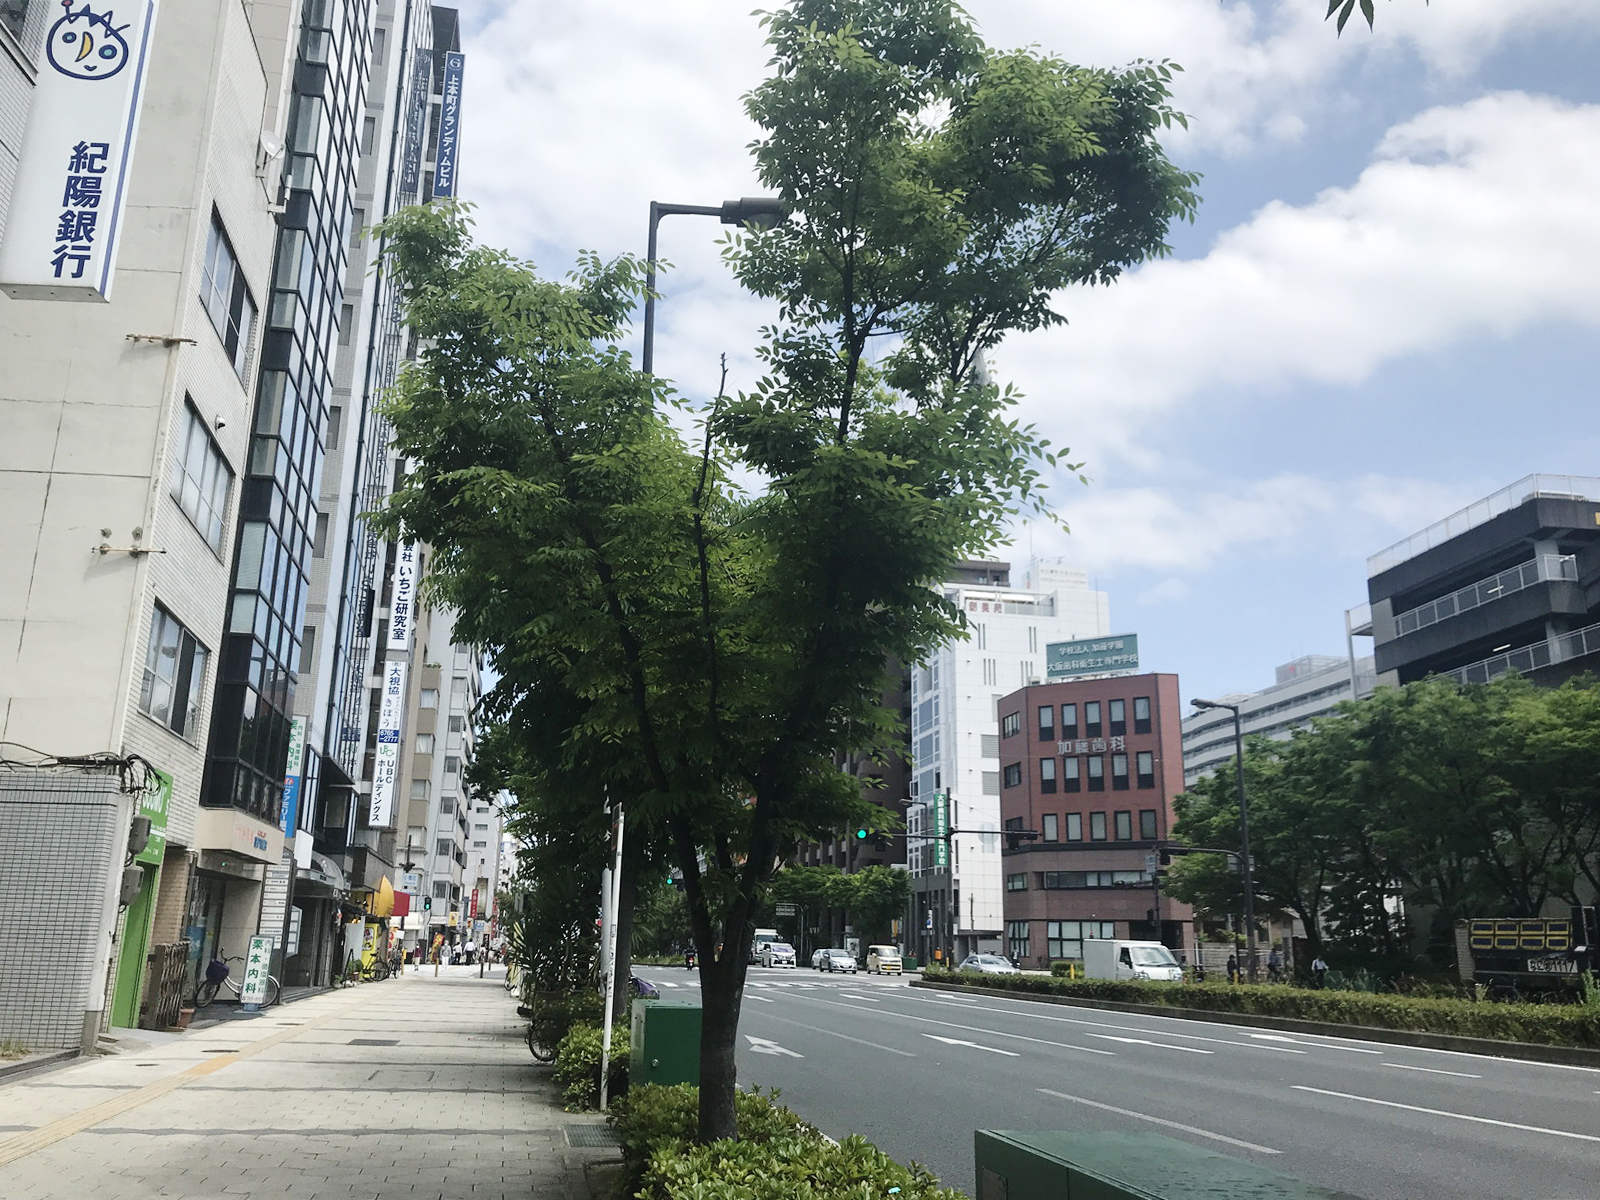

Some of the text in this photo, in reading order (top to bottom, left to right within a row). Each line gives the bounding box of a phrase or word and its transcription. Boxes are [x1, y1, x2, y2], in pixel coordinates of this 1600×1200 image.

[438, 74, 461, 187] 上本町グランディムビル
[50, 140, 109, 279] 紀陽銀行
[392, 565, 412, 641] いちご研究室
[385, 760, 395, 784] UBC
[1057, 735, 1126, 755] 加藤歯科
[372, 760, 386, 821] ホールディングス
